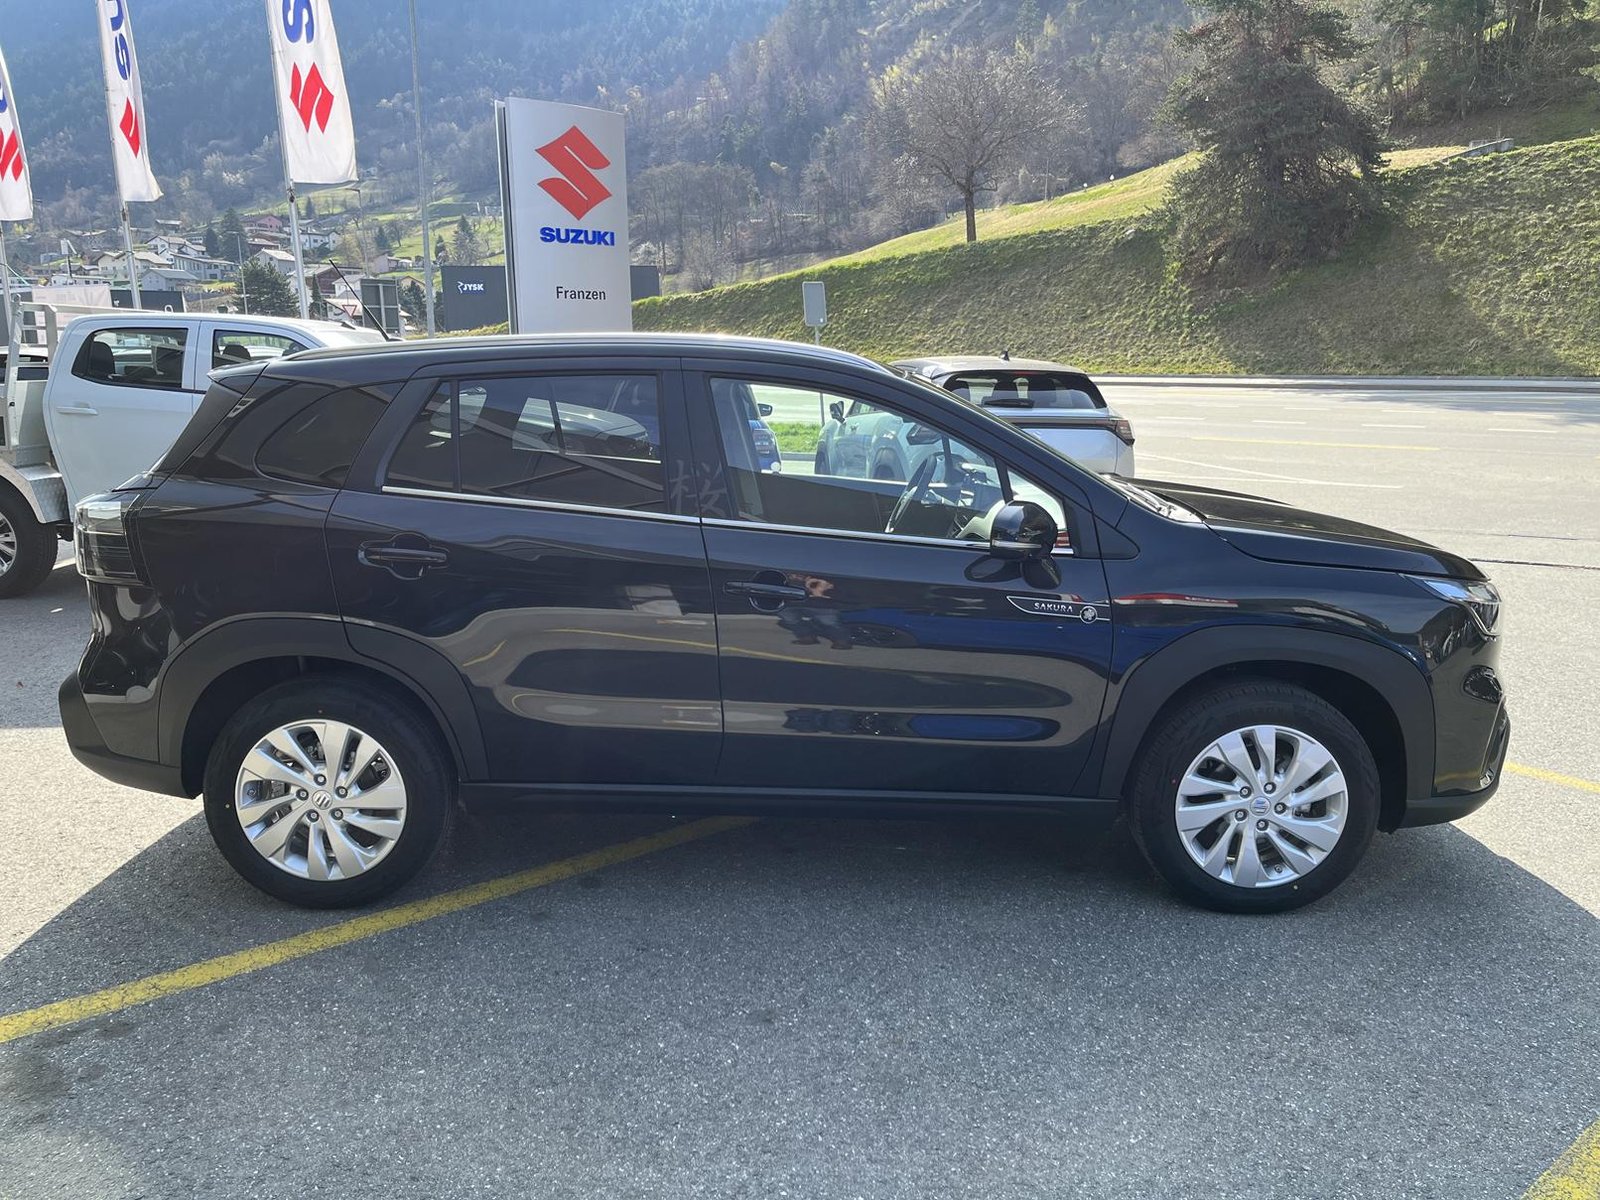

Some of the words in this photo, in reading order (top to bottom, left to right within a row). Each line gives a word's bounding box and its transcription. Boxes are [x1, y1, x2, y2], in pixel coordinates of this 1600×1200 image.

[540, 226, 615, 246] SUZUKI
[556, 286, 606, 301] Franzen
[1034, 602, 1073, 613] SAKURA
